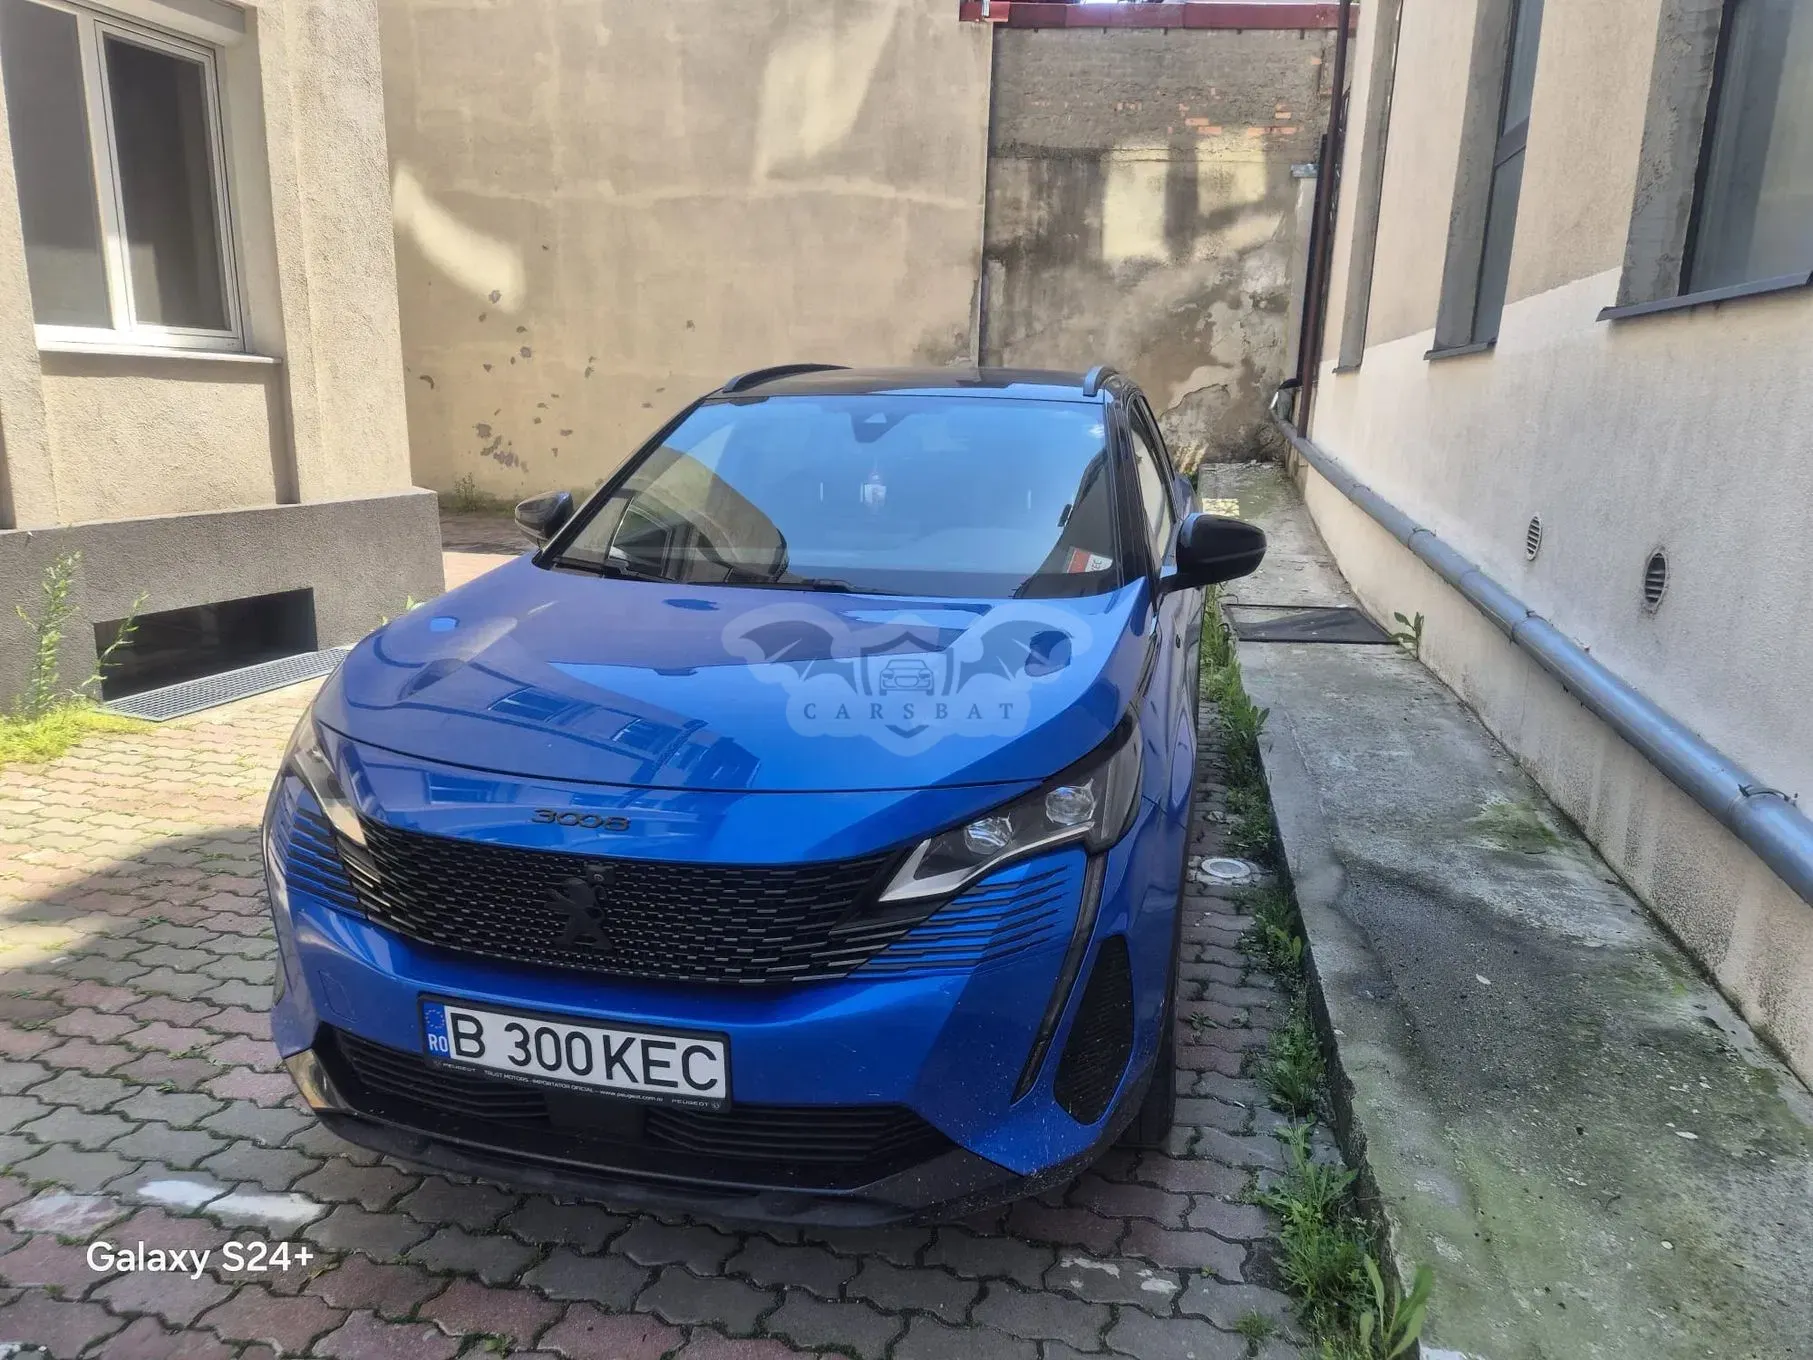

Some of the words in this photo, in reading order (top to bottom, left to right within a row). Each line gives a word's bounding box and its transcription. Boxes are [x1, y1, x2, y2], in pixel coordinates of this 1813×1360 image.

[531, 809, 631, 832] 3008
[428, 1033, 448, 1053] RO
[450, 1012, 486, 1059] B
[503, 1073, 530, 1083] MOTORS
[671, 1098, 709, 1108] PEUGEOT
